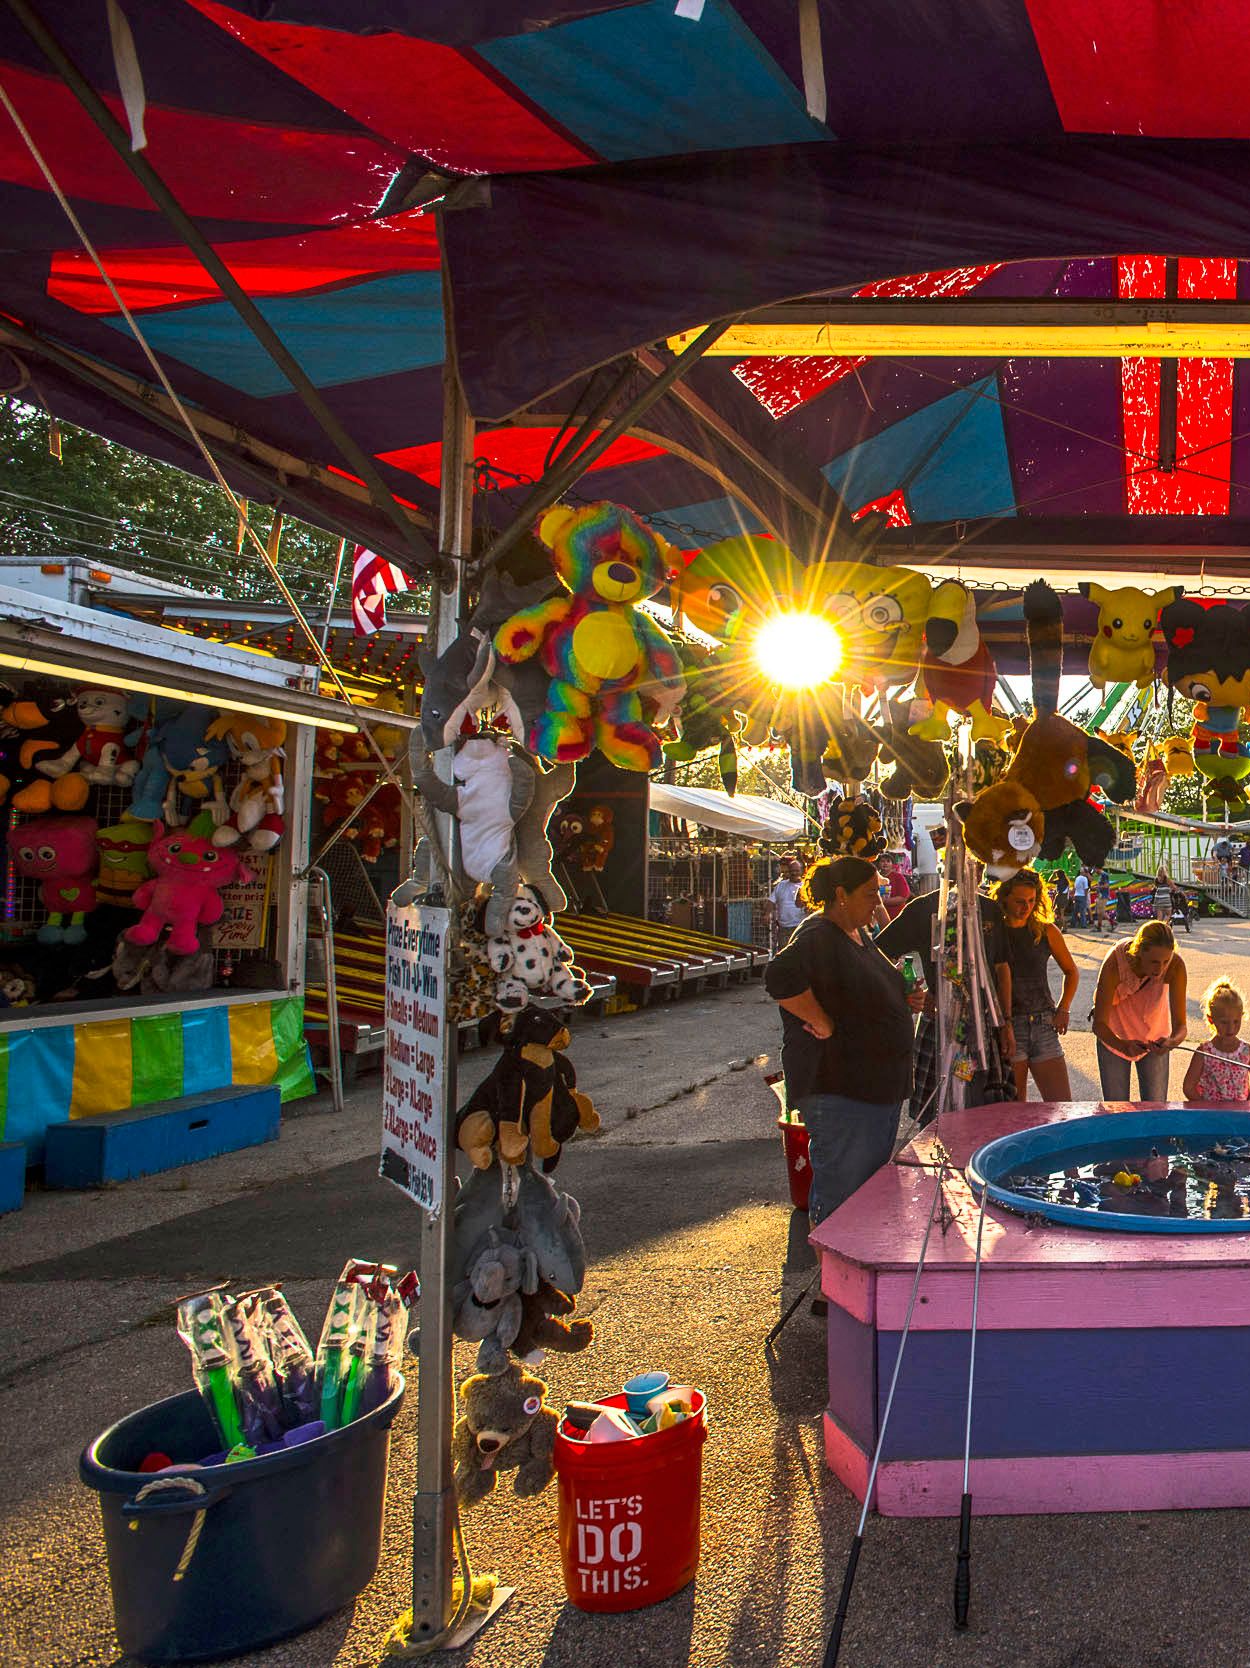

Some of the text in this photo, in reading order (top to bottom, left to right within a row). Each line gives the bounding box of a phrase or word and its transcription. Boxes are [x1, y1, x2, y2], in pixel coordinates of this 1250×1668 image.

[388, 916, 441, 962] Prize Everytime
[388, 955, 401, 988] Fish
[422, 964, 438, 1000] Win
[412, 999, 439, 1039] Medium
[415, 1041, 435, 1084] Large
[389, 1065, 405, 1107] Large
[409, 1077, 433, 1124] XLarge
[388, 1104, 409, 1149] XLarge
[413, 1119, 437, 1162] Choice
[575, 1494, 643, 1520] LET'S
[577, 1521, 642, 1566] DO
[577, 1565, 649, 1594] THIS.
